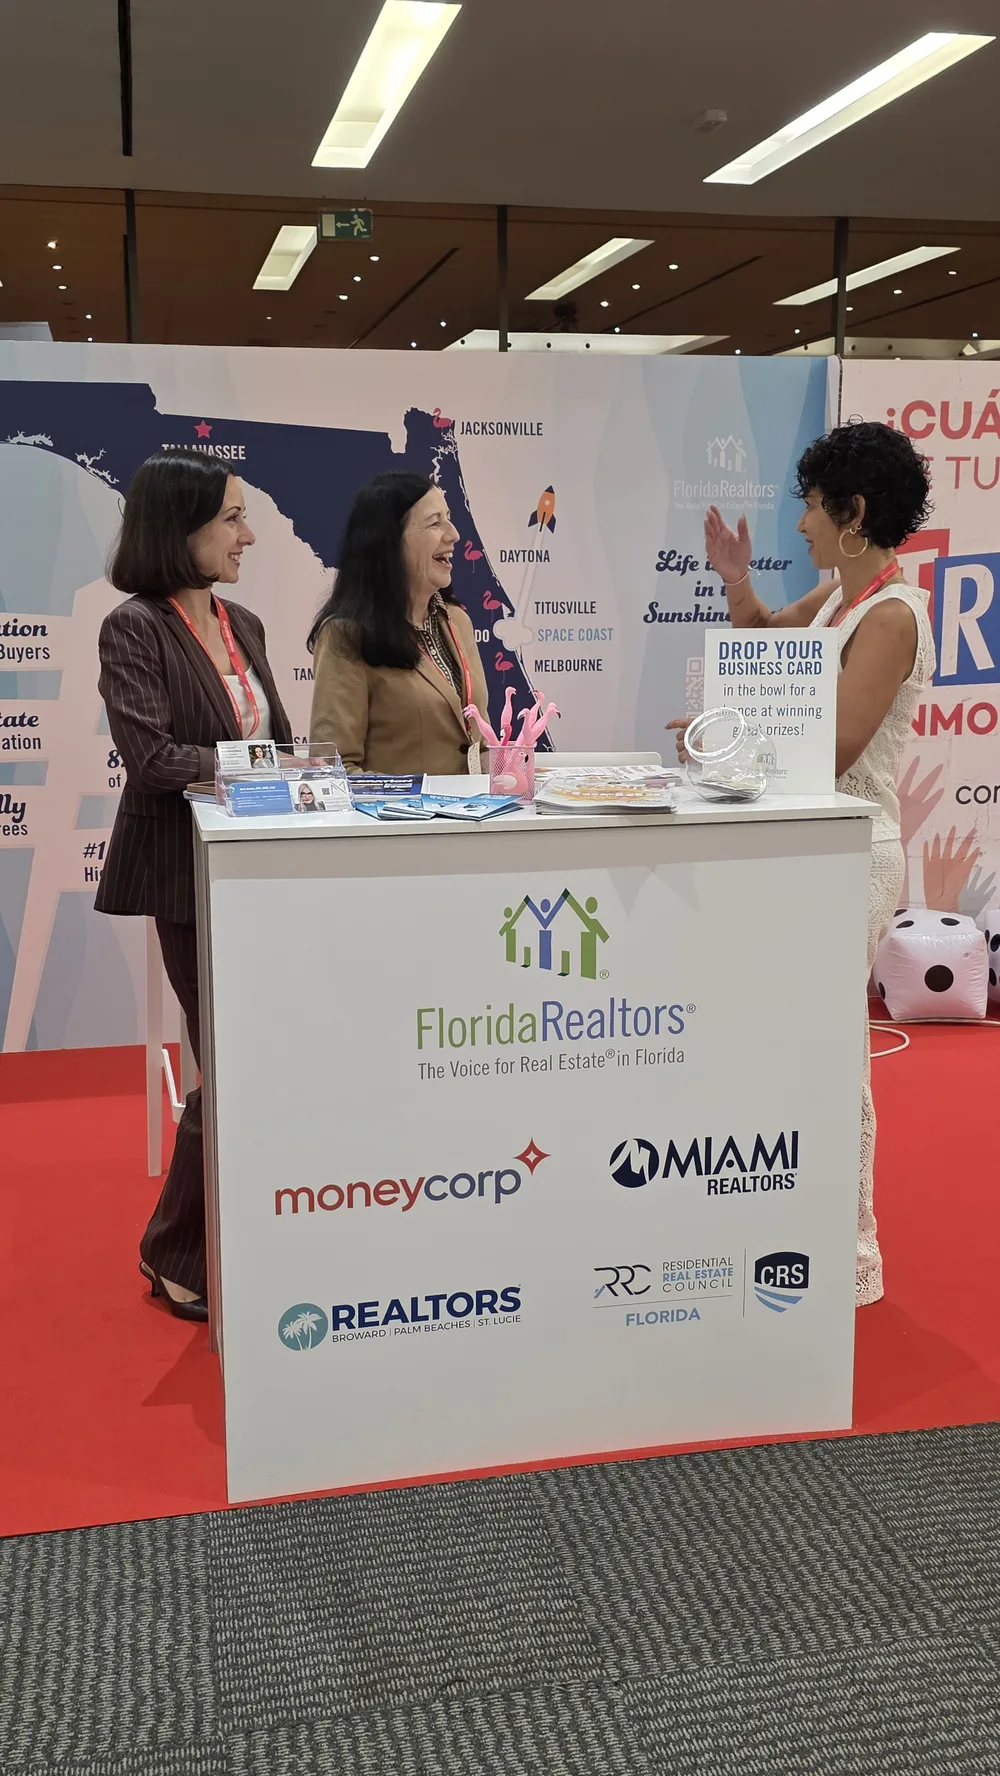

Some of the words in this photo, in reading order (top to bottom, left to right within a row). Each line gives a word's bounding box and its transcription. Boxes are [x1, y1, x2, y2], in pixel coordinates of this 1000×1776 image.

[460, 421, 543, 436] JACKSONVILLE
[500, 549, 550, 564] DAYTONA
[655, 549, 699, 576] Life
[749, 556, 793, 571] etter
[694, 580, 714, 597] in
[534, 601, 597, 615] TITUSVILLE
[0, 618, 48, 637] tion
[537, 628, 574, 642] SPACE
[578, 627, 614, 642] COAST
[719, 641, 768, 660] DROP
[774, 640, 823, 660] YOUR
[534, 658, 603, 673] MELBOURNE
[718, 662, 783, 675] BUSINESS
[787, 661, 822, 675] CARD
[723, 683, 734, 696] in
[738, 684, 756, 696] the
[760, 683, 786, 696] bowl
[789, 682, 806, 696] for
[809, 686, 816, 696] a
[761, 704, 773, 717] at
[776, 704, 823, 719] winning
[0, 712, 40, 728] ate
[108, 774, 121, 788] of
[0, 824, 28, 836] ees
[83, 841, 106, 860] #1
[418, 1062, 445, 1080] The
[450, 1059, 490, 1078] Voice
[495, 1056, 516, 1074] for
[520, 1053, 553, 1073] Real
[617, 1050, 630, 1067] in
[636, 1046, 685, 1066] Florida
[662, 1130, 799, 1179] MIAMI
[275, 1169, 522, 1216] moneycorp
[707, 1173, 796, 1196] REALTORS
[662, 1256, 734, 1272] RESIDENTIAL
[663, 1271, 692, 1283] REAL
[695, 1267, 734, 1280] ESTATE
[760, 1263, 804, 1287] CRS
[662, 1278, 734, 1293] COUNCIL
[331, 1286, 521, 1332] REALTORS
[625, 1307, 701, 1327] FLORIDA
[332, 1329, 387, 1343] BROWARD
[394, 1325, 422, 1337] PALM
[424, 1319, 471, 1334] BEACHES
[477, 1317, 492, 1328] ST.
[493, 1314, 522, 1326] LUCIE
